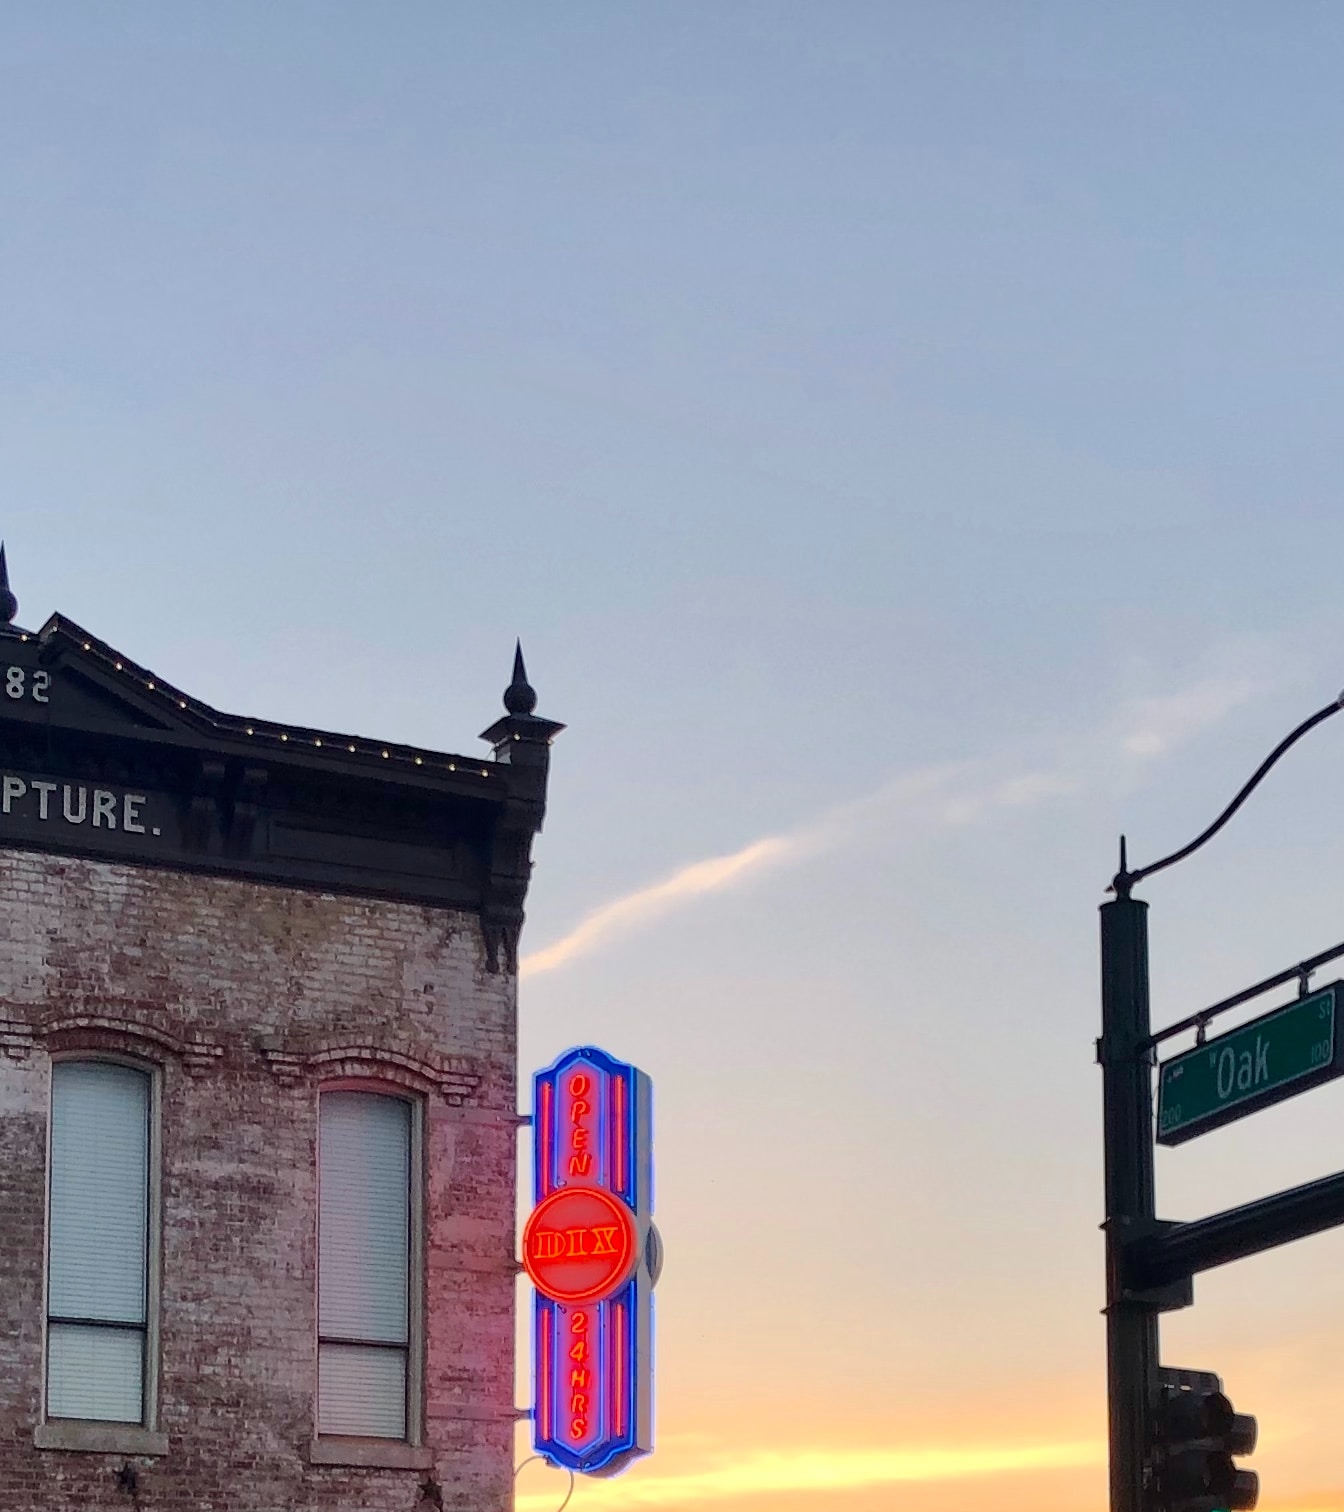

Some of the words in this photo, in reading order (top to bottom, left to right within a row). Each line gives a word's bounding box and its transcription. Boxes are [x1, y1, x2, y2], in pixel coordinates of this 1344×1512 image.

[1217, 1035, 1270, 1099] Oak
[1311, 1039, 1330, 1064] 100
[568, 1074, 592, 1179] OPEN
[532, 1226, 619, 1260] DIX
